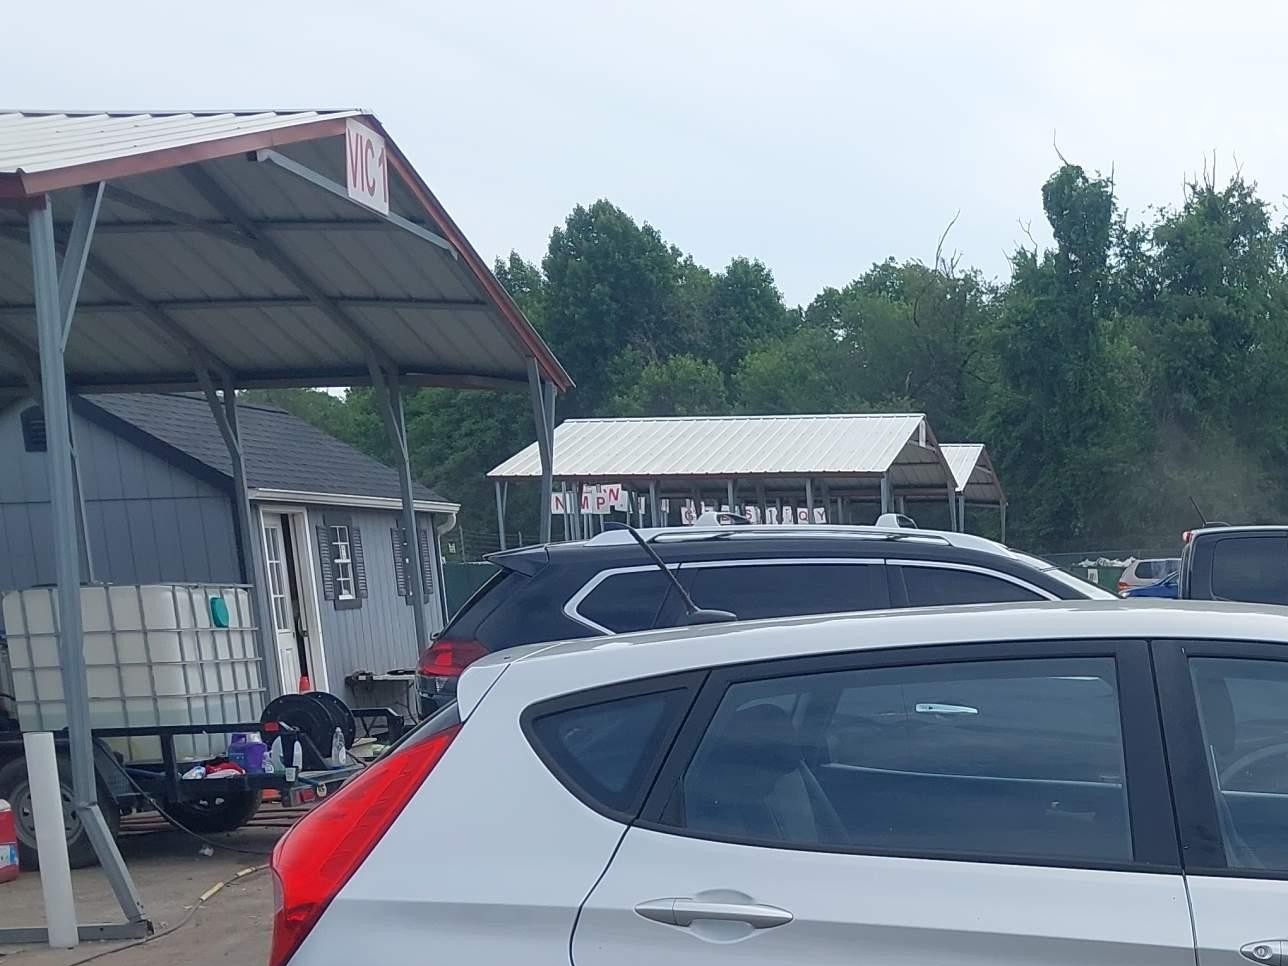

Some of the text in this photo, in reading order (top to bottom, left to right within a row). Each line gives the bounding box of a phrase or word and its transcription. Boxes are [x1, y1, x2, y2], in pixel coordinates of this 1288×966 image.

[346, 127, 388, 203] VIC 1
[596, 496, 606, 510] P
